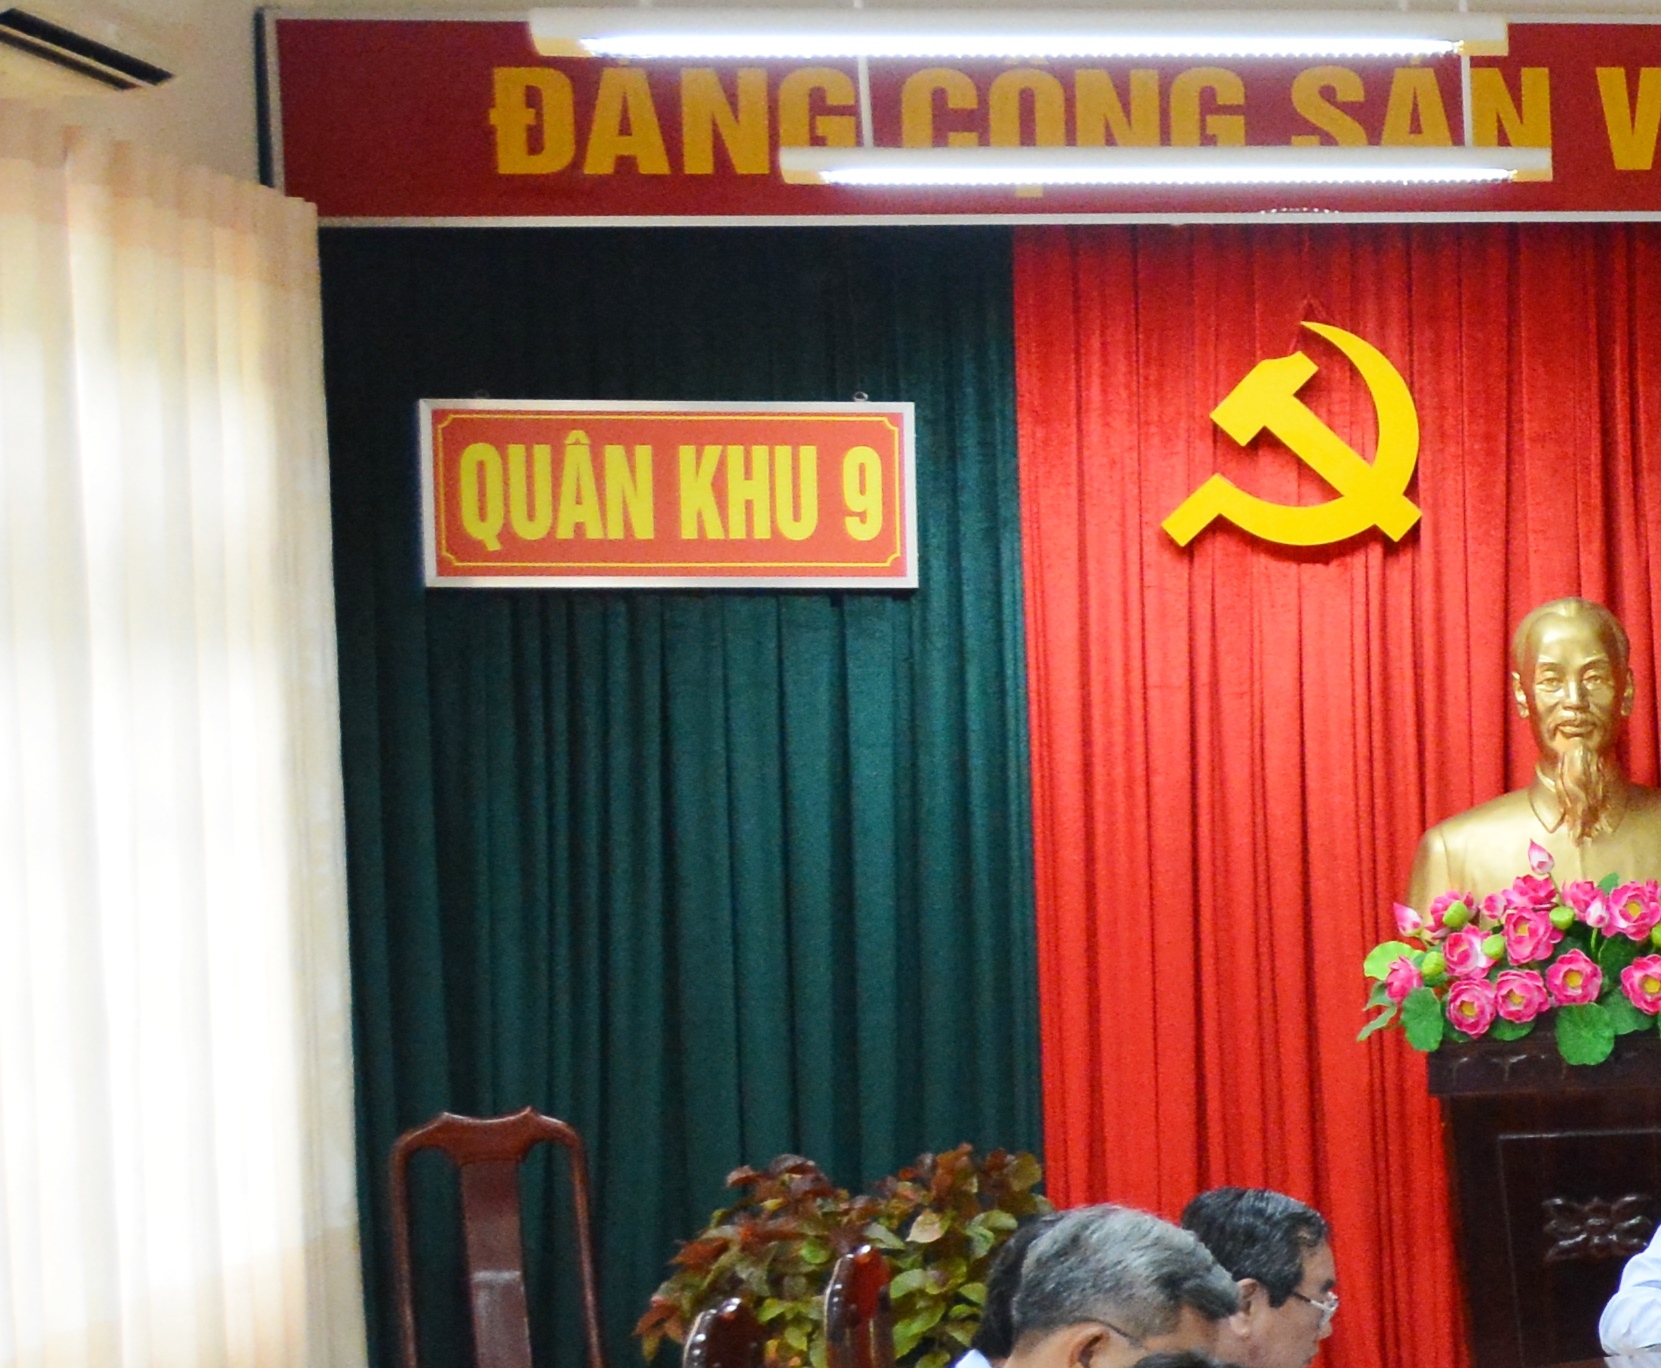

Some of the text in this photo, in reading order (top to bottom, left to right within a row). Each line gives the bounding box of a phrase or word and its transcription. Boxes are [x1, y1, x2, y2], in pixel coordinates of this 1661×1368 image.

[459, 429, 884, 551] QUÂN KHU 9
